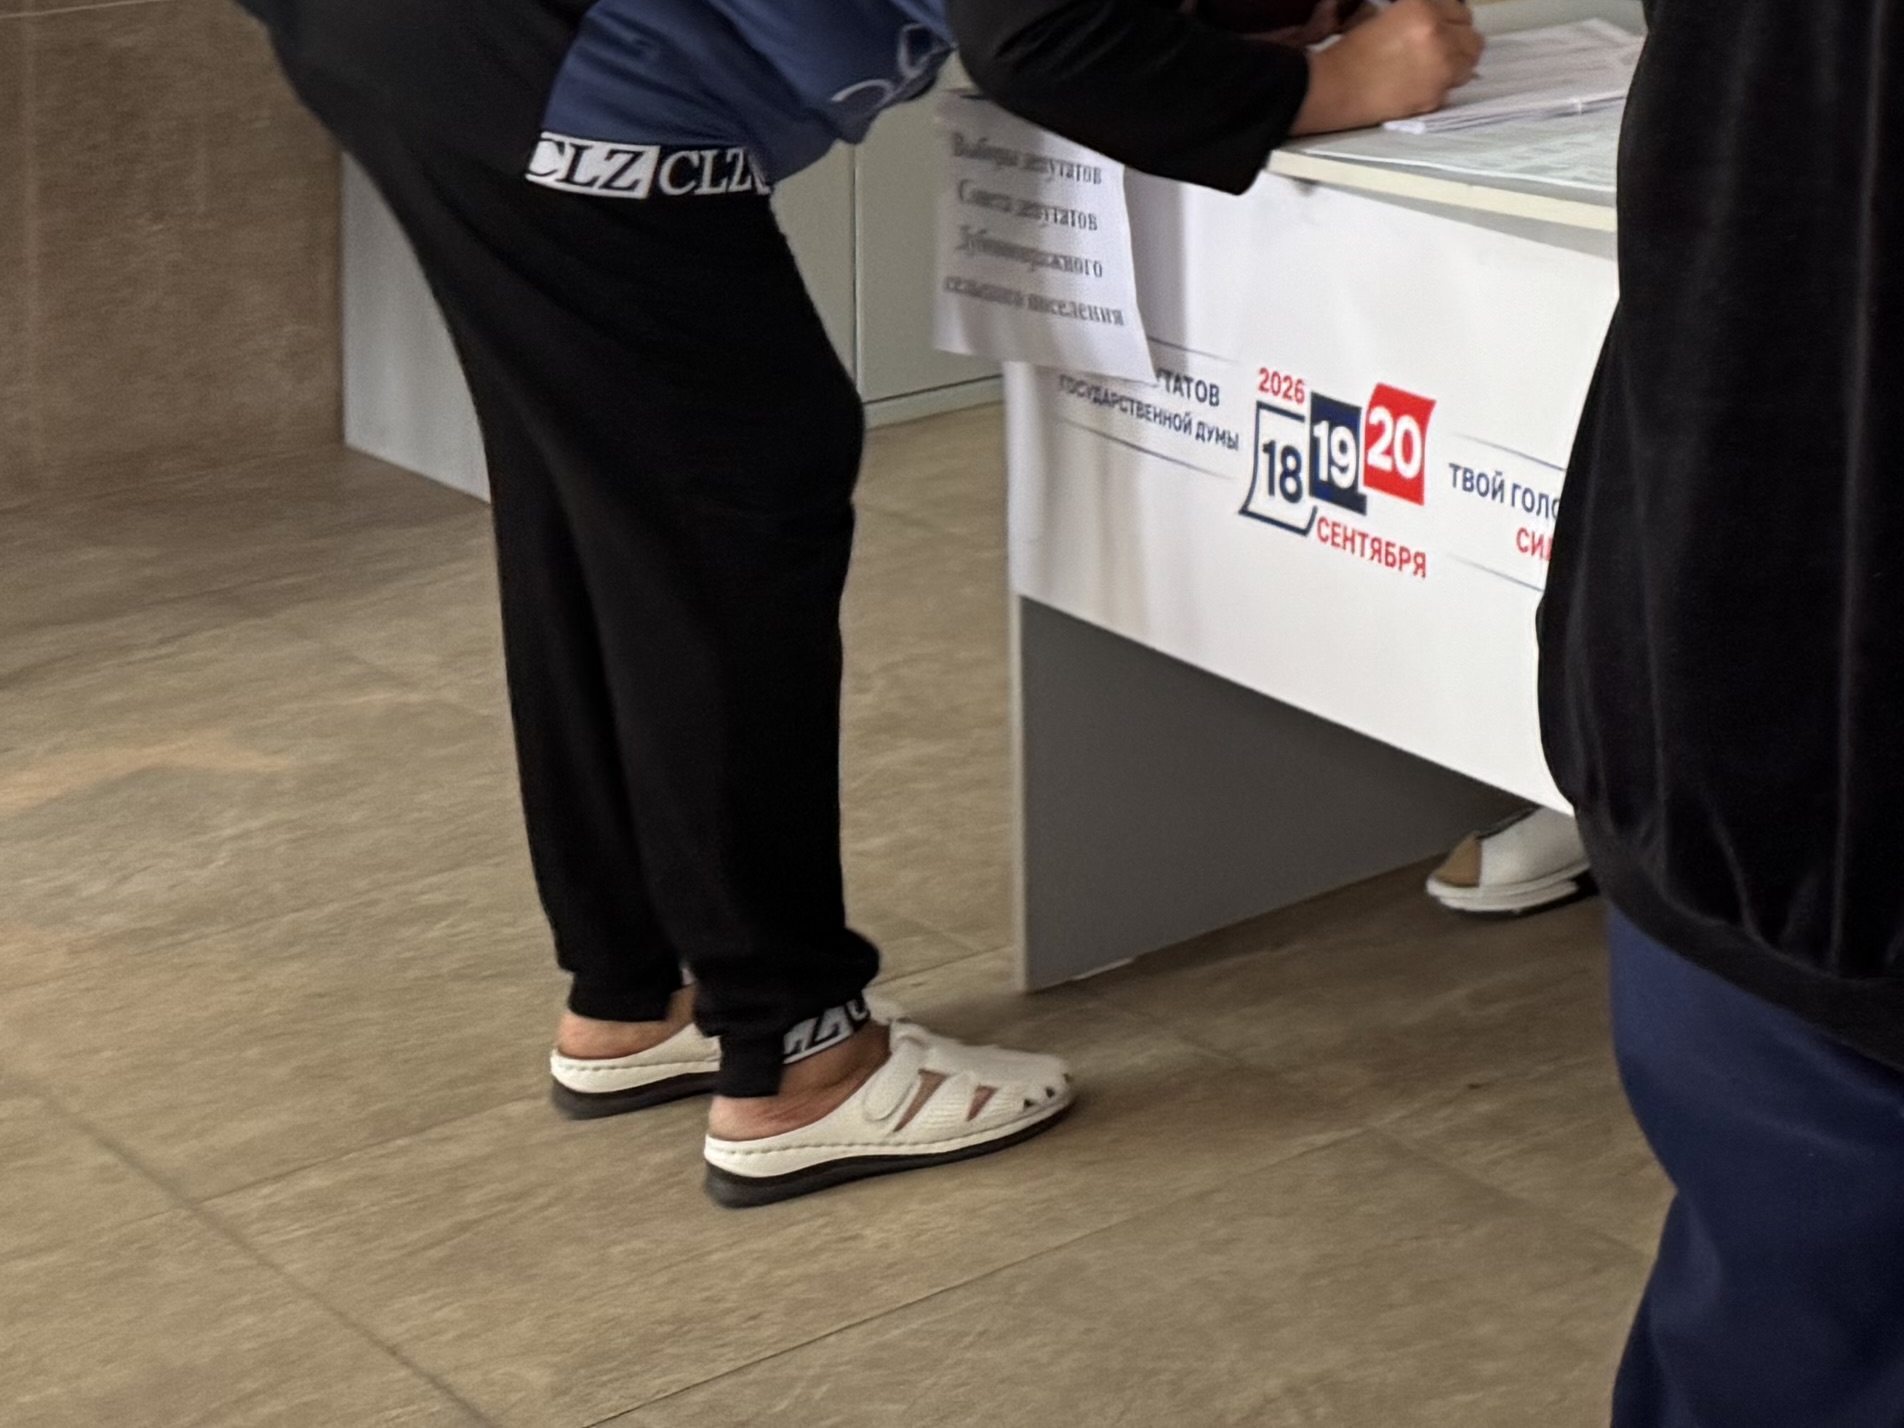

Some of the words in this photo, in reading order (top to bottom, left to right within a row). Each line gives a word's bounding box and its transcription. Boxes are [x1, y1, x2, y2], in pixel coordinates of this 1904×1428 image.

[1058, 373, 1192, 436] ГОСУДАРСТВЕННОЙ
[1196, 420, 1240, 452] ДУМЫ
[1258, 367, 1306, 406] 2026
[1261, 439, 1304, 504] 18
[1313, 420, 1357, 490] 19
[1366, 405, 1423, 480] 20
[1448, 462, 1505, 504] ТВОЙ
[1316, 516, 1427, 580] СЕНТЯБРЯ
